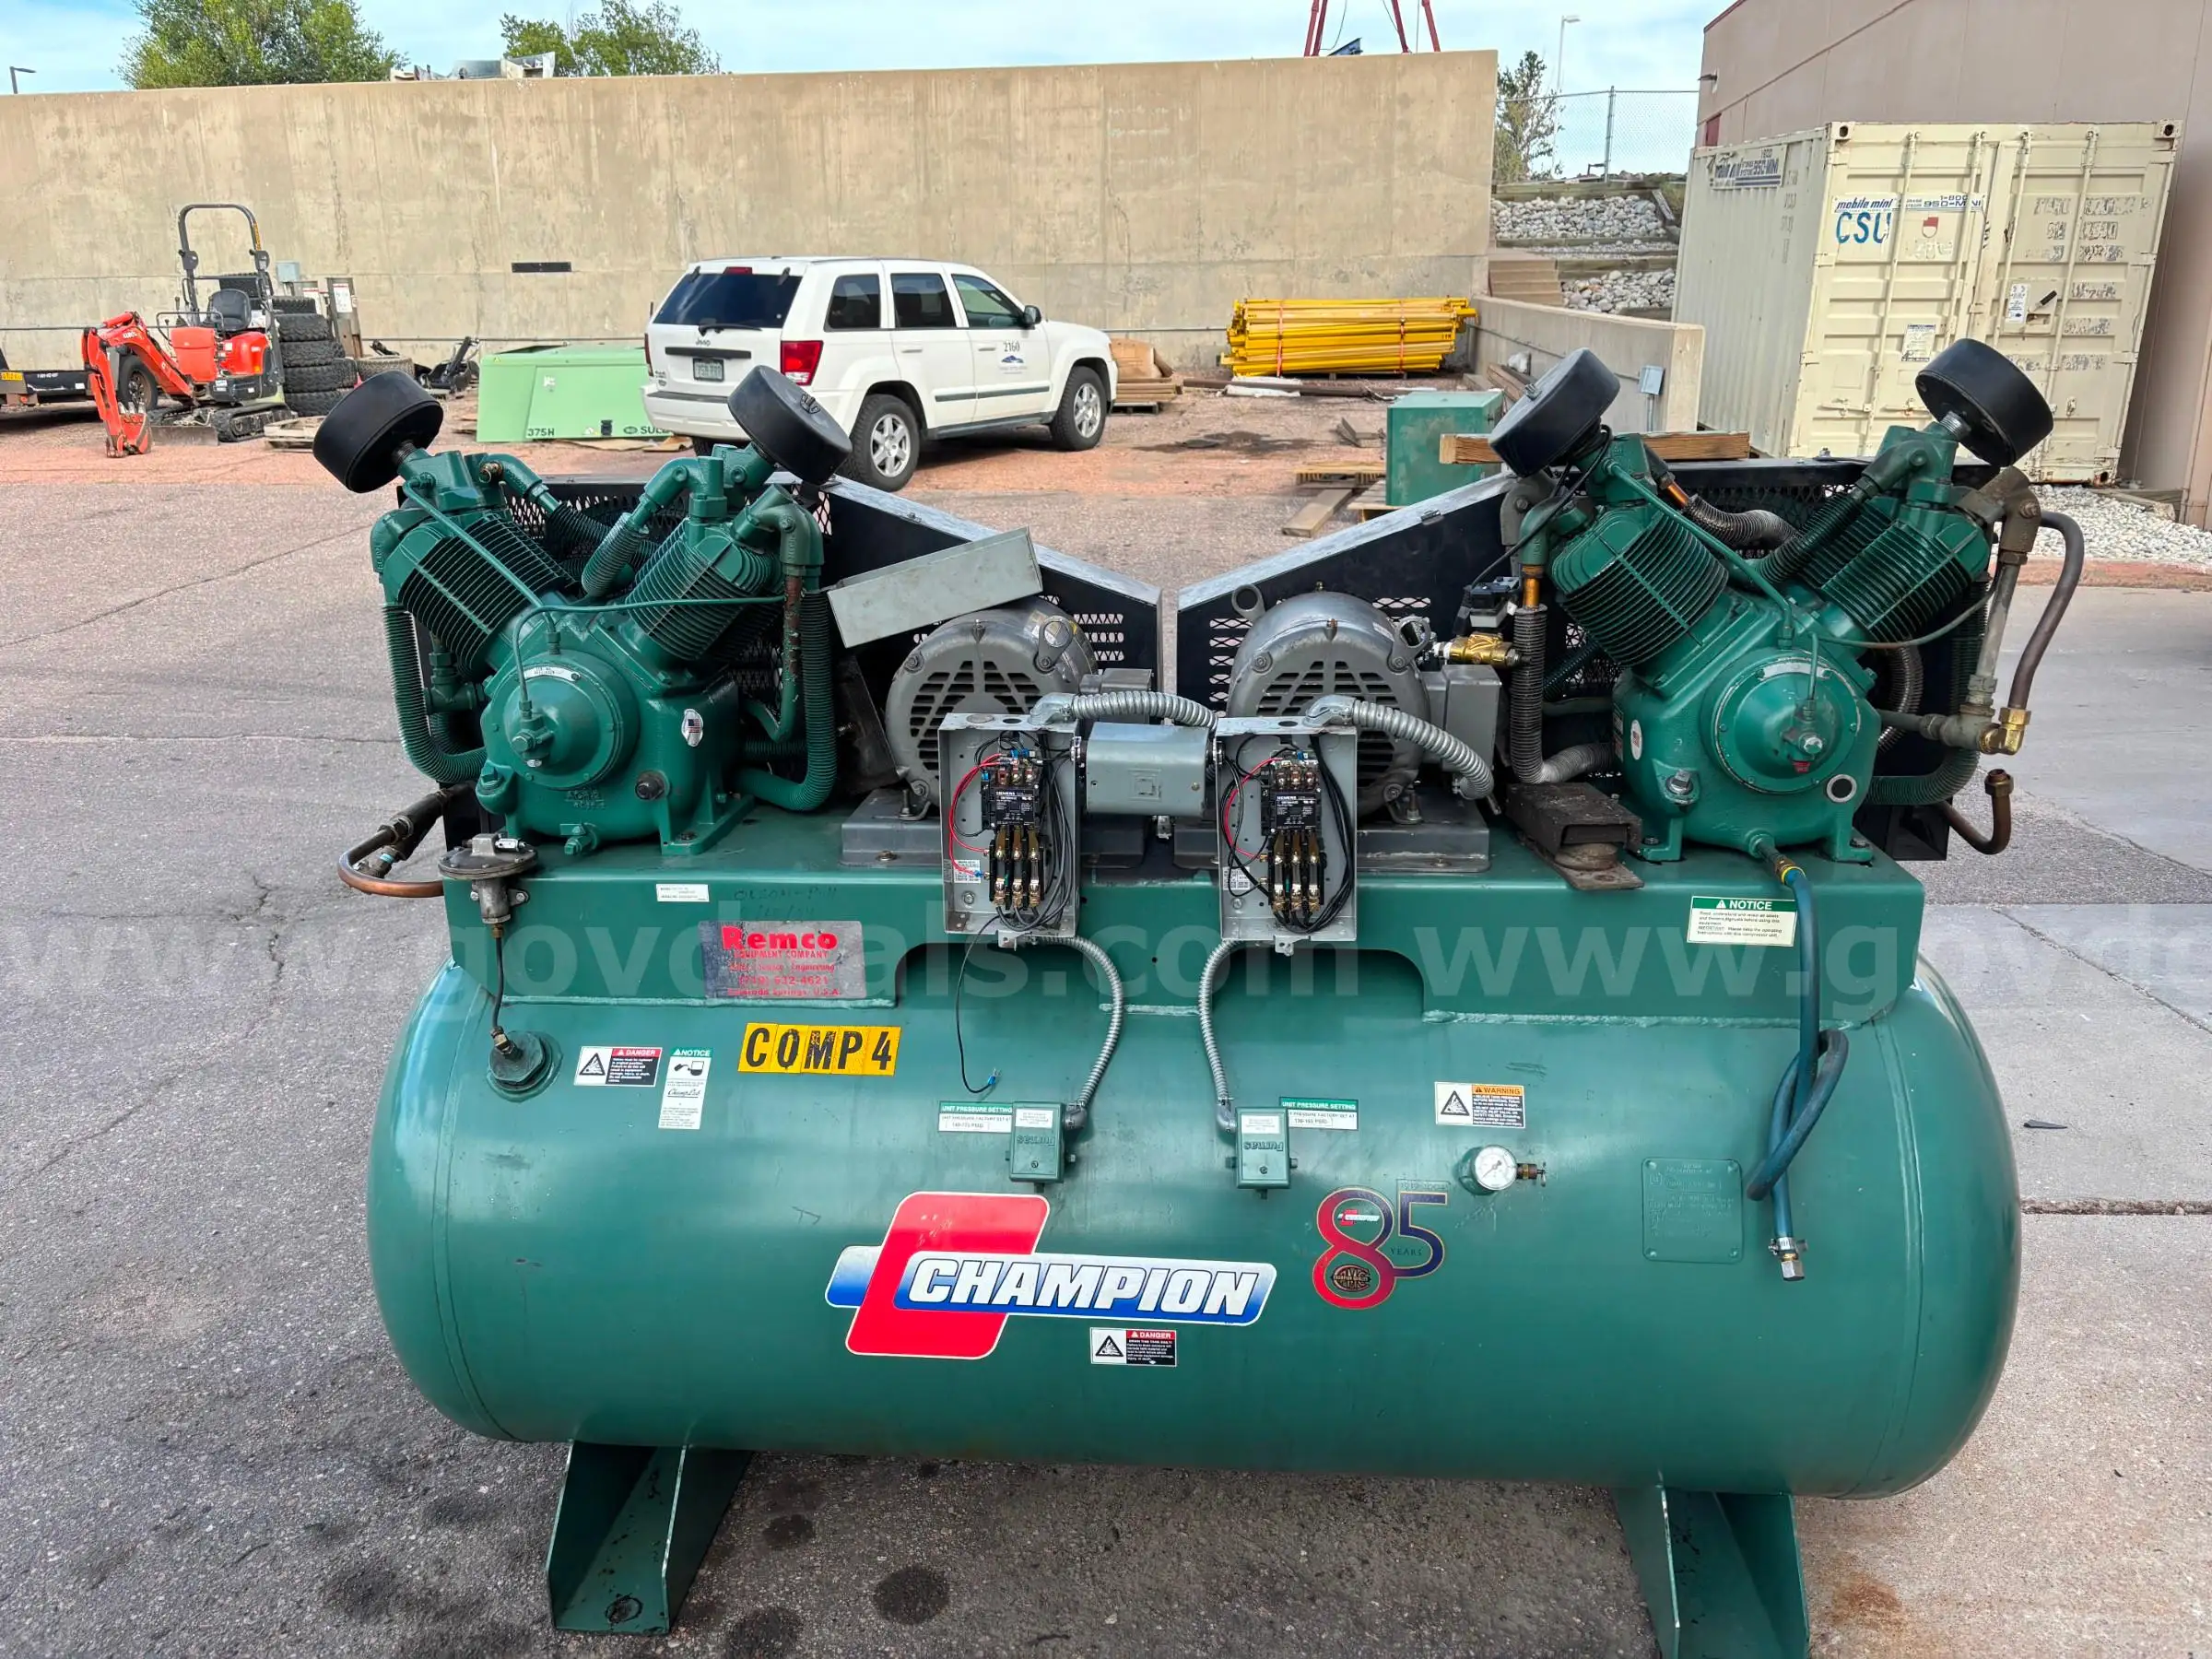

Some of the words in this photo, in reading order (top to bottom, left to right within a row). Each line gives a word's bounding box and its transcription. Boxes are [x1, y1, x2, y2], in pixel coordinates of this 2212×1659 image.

[1835, 197, 1869, 212] mobile
[1870, 198, 1893, 208] mini
[1836, 211, 1892, 243] CSU
[527, 428, 554, 437] 375H
[1729, 900, 1772, 911] NOTICE
[721, 924, 838, 950] Remco
[786, 950, 828, 959] COMPANY
[626, 1049, 655, 1057] DANGER
[1484, 1087, 1521, 1095] WARNING
[1390, 1247, 1422, 1256] YEARS
[907, 1258, 1259, 1316] CHAMPION
